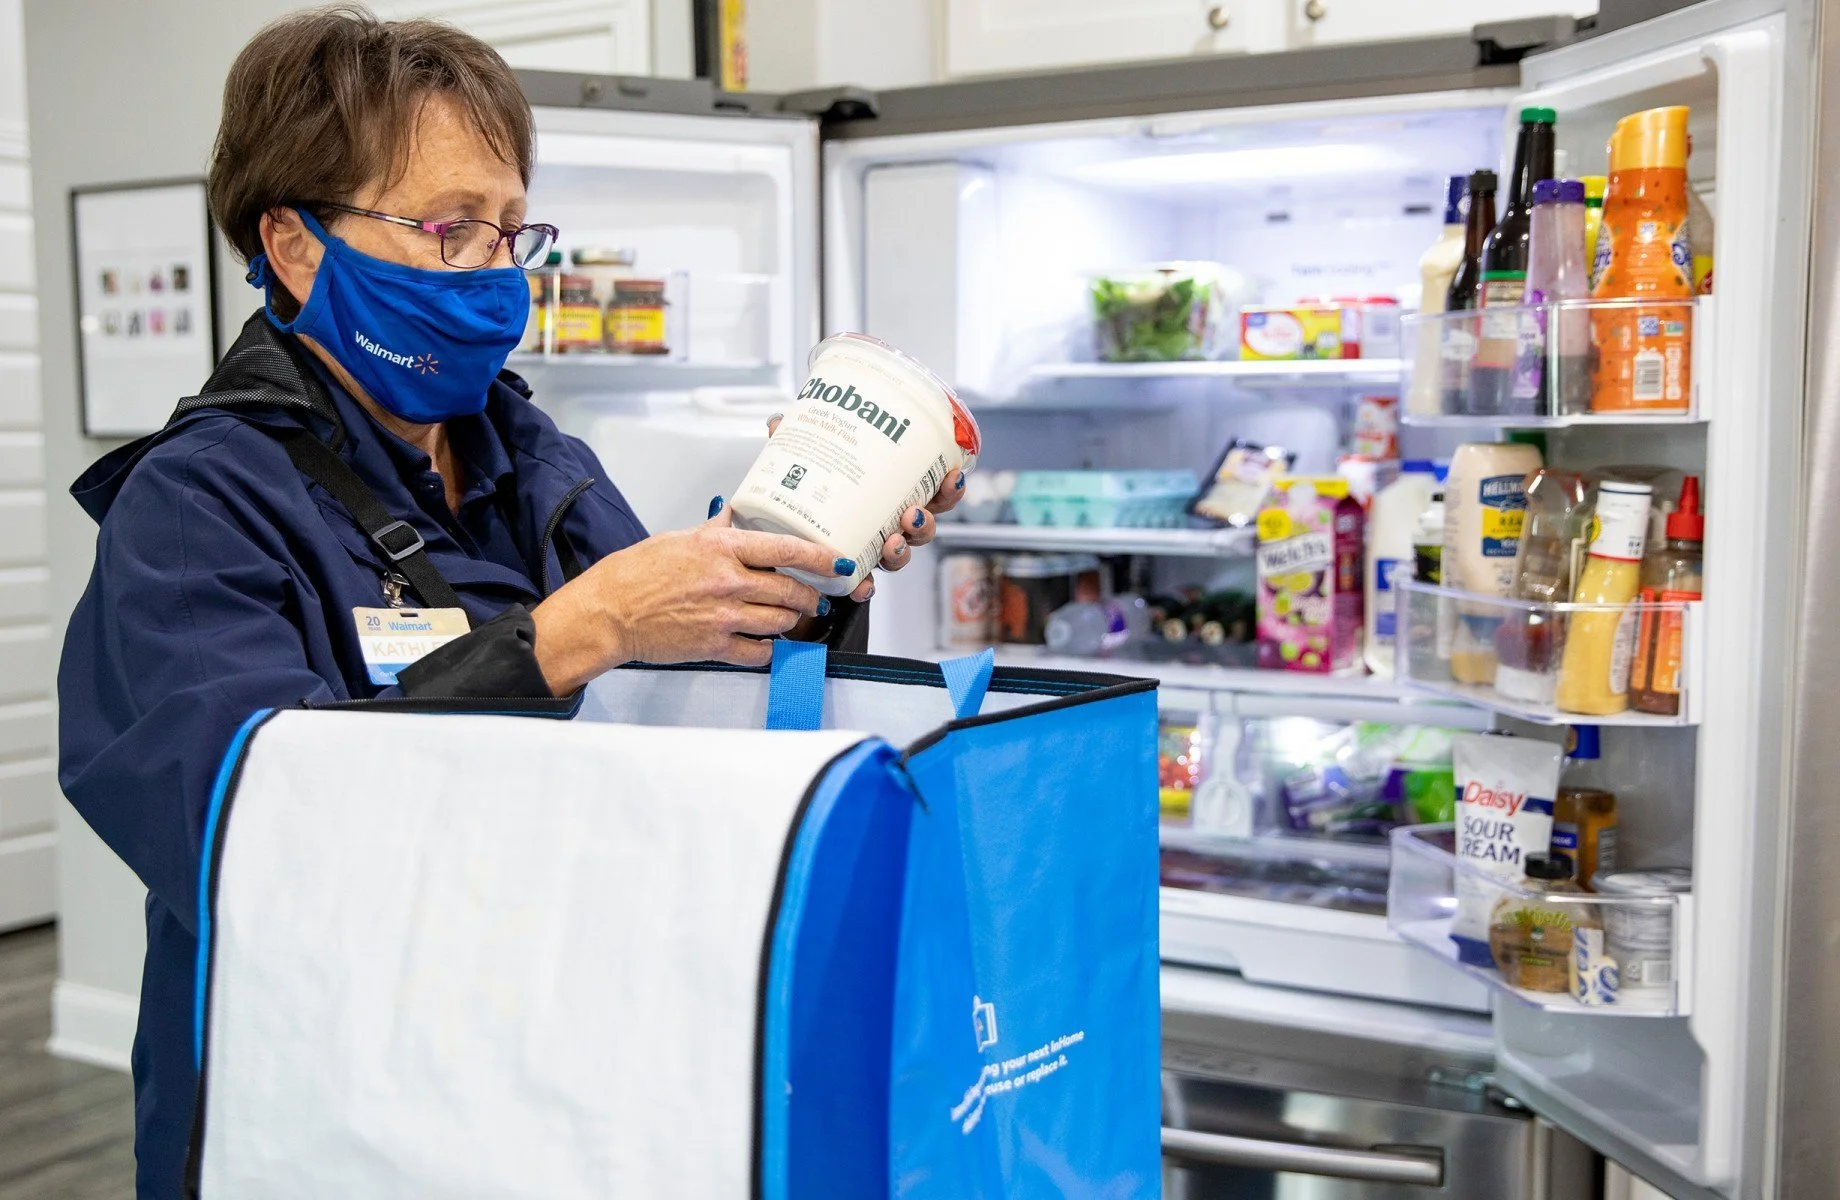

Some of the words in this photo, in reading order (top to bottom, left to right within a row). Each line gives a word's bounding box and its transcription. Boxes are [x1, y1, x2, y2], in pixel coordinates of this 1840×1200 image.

[355, 330, 414, 368] Walmart
[796, 377, 911, 444] Chobani
[808, 406, 830, 420] Greek
[831, 411, 858, 434] Yogurt
[797, 413, 821, 426] Whole
[819, 419, 838, 434] Milk
[836, 428, 858, 447] Plain
[365, 615, 381, 627] 20
[388, 620, 433, 632] Walmart
[1463, 780, 1523, 817] Daisy
[1463, 815, 1514, 843] SOUR
[1461, 837, 1521, 865] REAM
[1001, 1055, 1027, 1076] your
[1027, 1043, 1049, 1063] next
[1050, 1030, 1085, 1054] InHome
[983, 1079, 1013, 1096] euse
[1013, 1074, 1026, 1088] or
[1026, 1060, 1060, 1084] replace
[1058, 1053, 1069, 1068] it.
